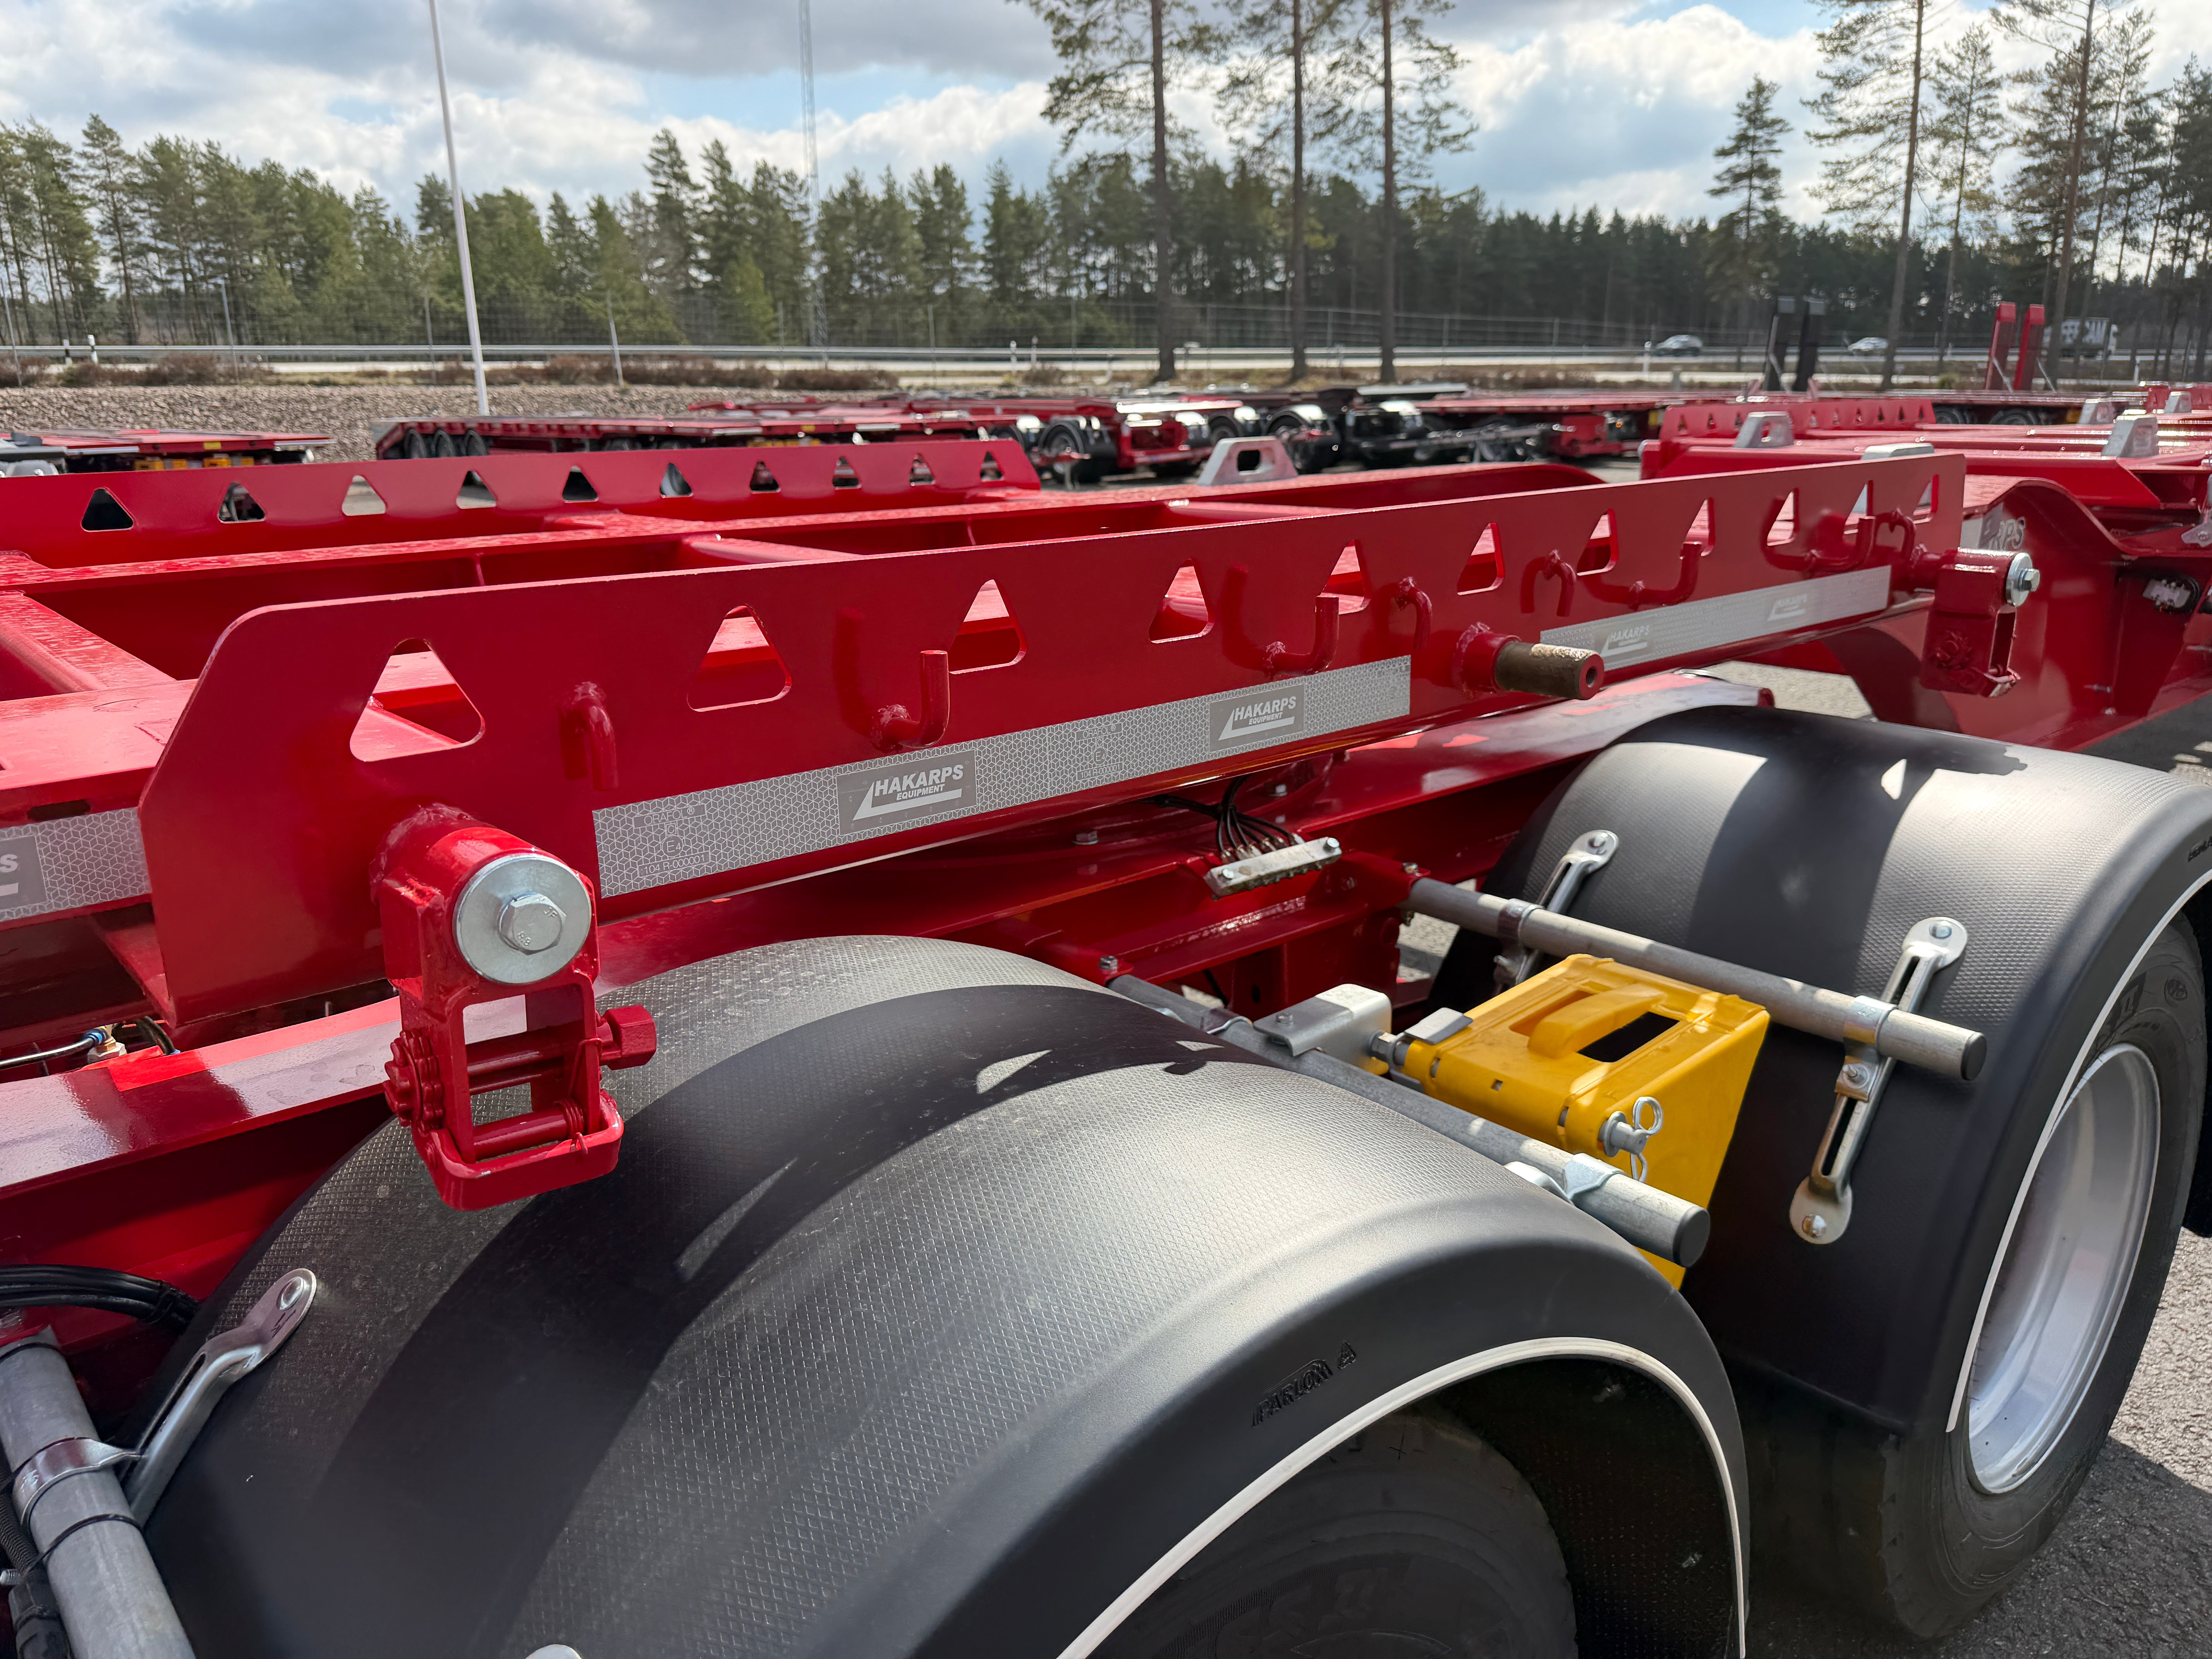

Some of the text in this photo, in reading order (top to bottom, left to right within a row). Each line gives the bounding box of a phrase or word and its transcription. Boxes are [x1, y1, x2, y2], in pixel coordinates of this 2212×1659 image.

[1234, 696, 1297, 721] HAKARPS
[1249, 712, 1283, 725] EQUIPMENT
[874, 764, 963, 797] HAKARPS
[896, 784, 945, 801] EQUIPMENT
[644, 854, 704, 874] 104 R-000001
